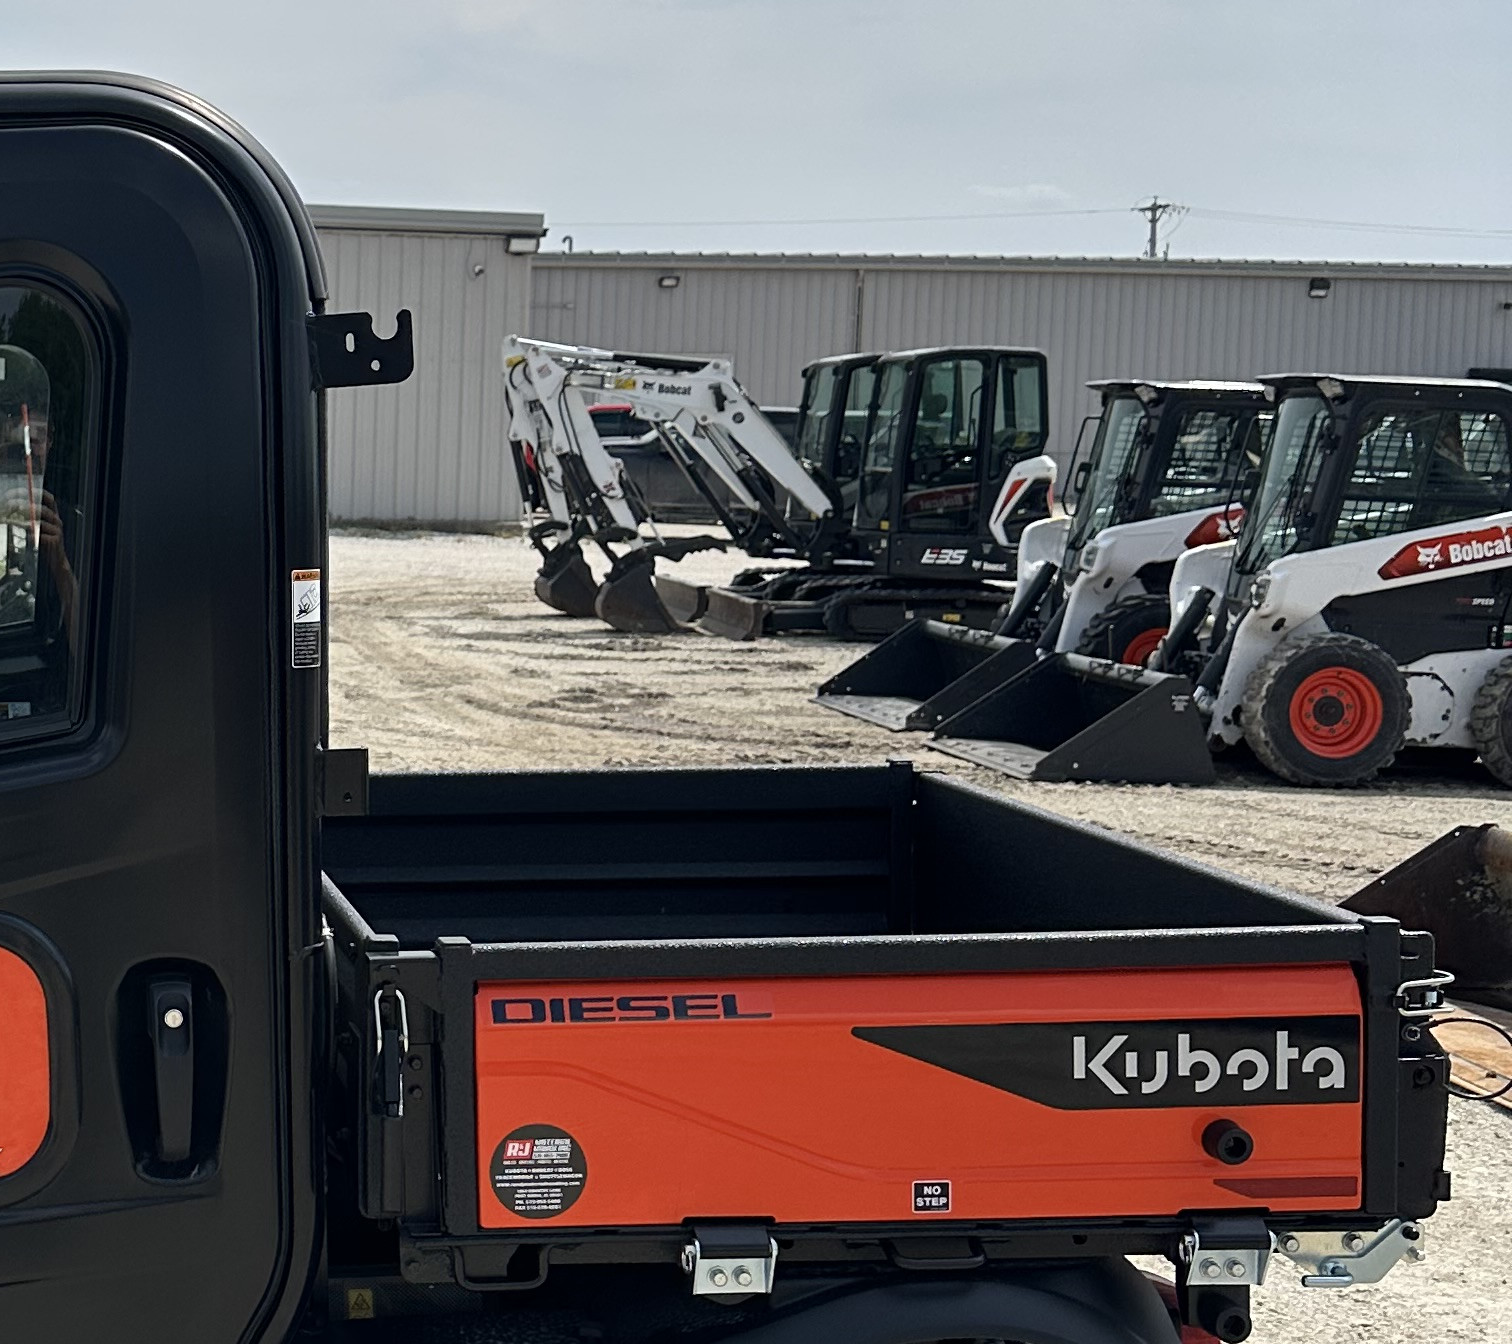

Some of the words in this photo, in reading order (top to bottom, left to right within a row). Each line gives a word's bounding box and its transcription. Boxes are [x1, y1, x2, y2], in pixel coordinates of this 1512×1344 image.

[1449, 534, 1512, 564] Bobcat
[491, 994, 773, 1024] DIESEL
[1073, 1030, 1346, 1095] Kubota
[916, 1196, 948, 1207] STEP
[923, 1185, 942, 1196] NO
